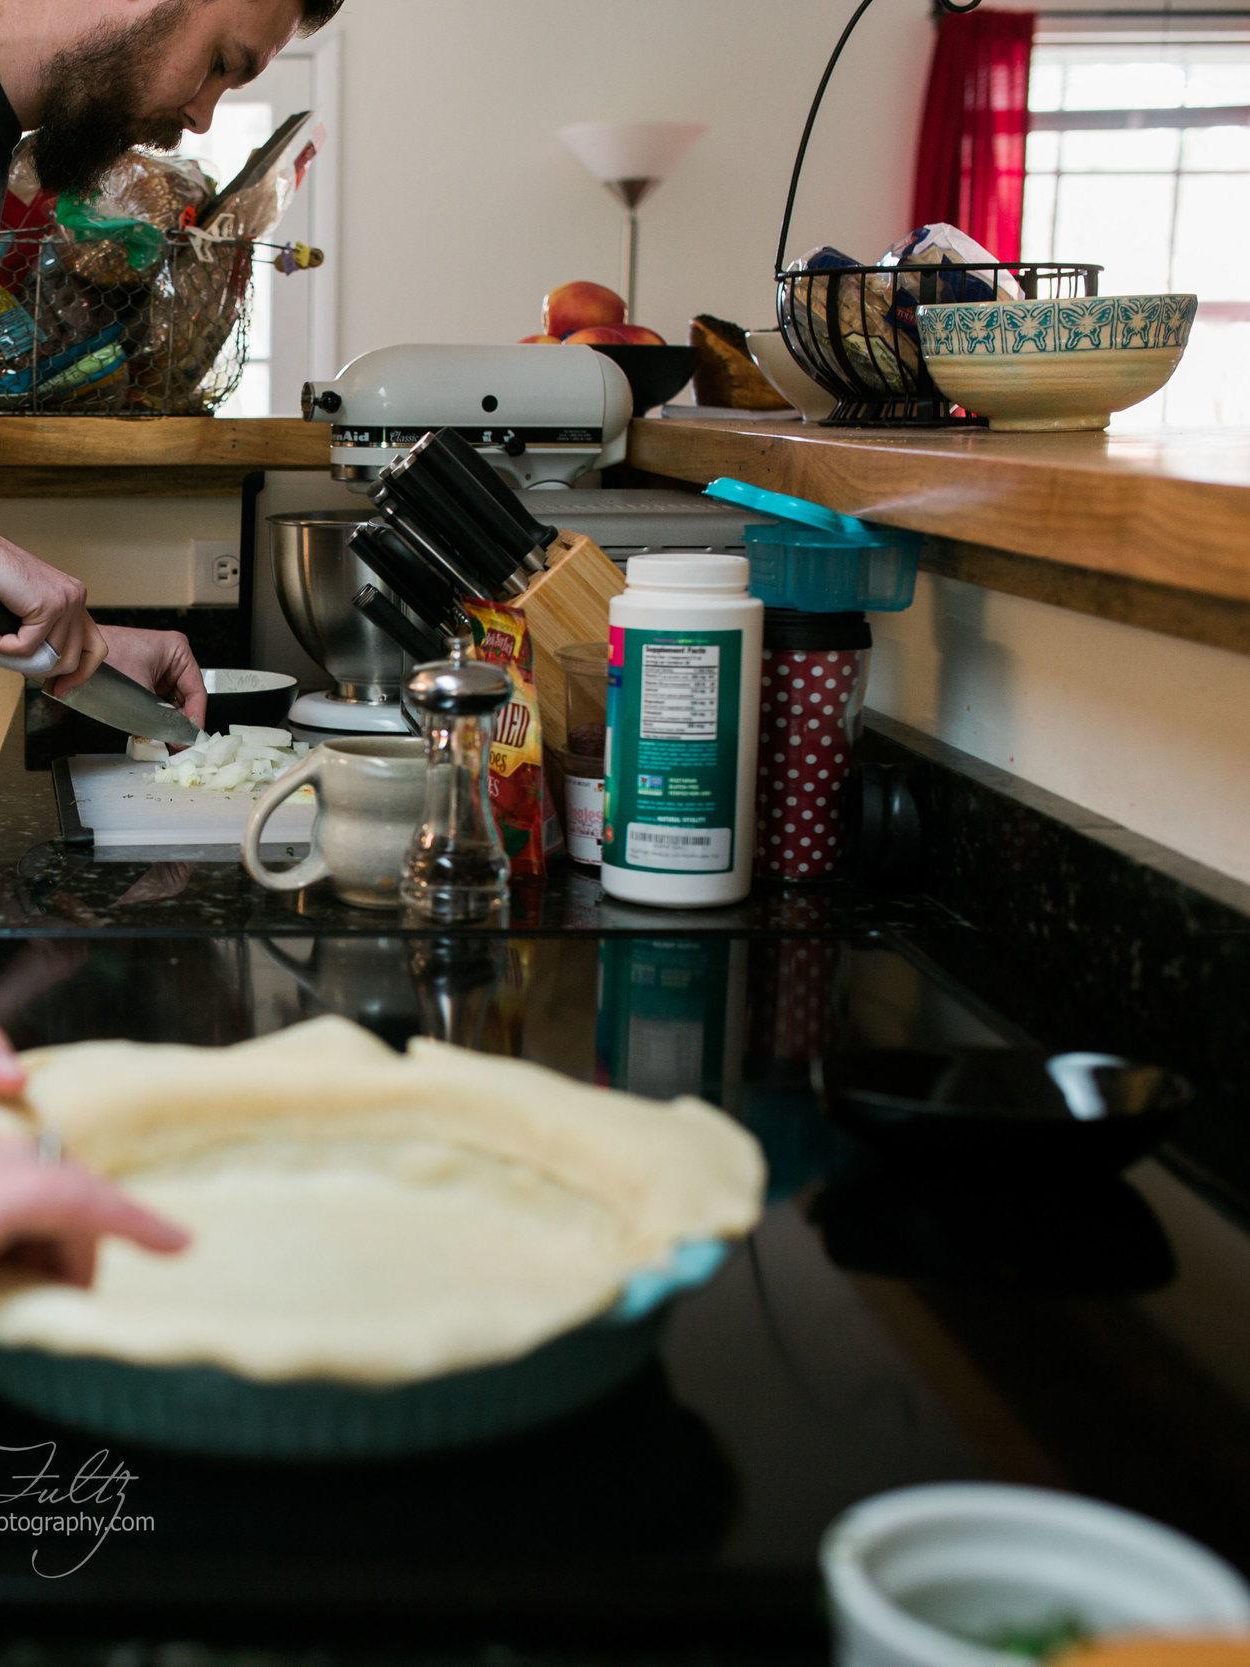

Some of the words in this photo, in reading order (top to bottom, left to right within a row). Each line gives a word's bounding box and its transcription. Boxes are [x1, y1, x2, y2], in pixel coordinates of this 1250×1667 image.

[389, 430, 418, 442] Classic
[646, 646, 685, 654] Supplement
[487, 775, 500, 797] ES
